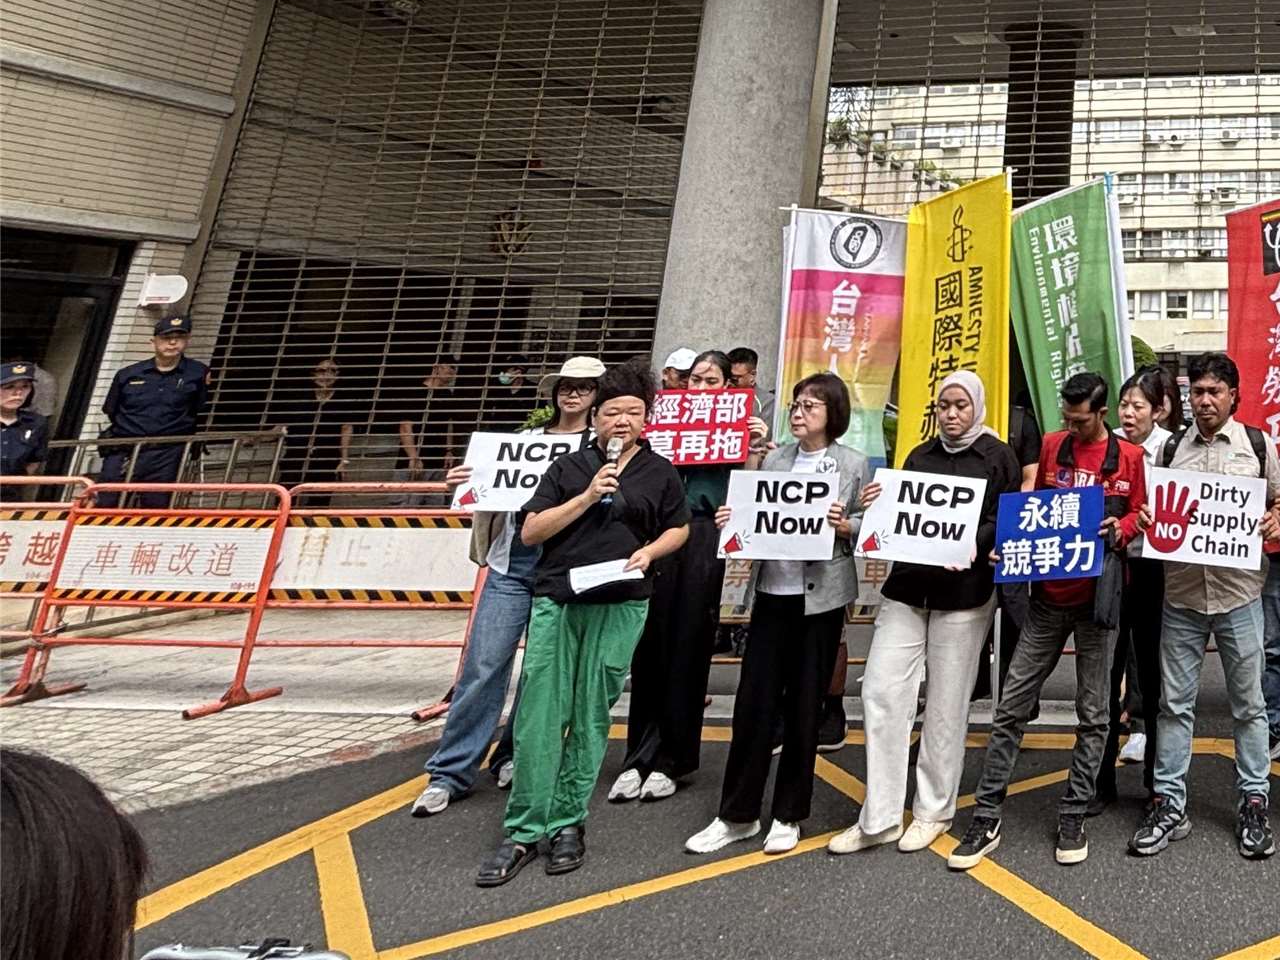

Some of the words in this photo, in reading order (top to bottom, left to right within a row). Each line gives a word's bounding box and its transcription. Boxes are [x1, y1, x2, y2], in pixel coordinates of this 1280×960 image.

[1028, 225, 1059, 341] Environmental
[963, 266, 983, 353] AMNESTY
[648, 392, 748, 425] 經濟部
[496, 442, 572, 462] NCP
[646, 428, 744, 461] 莫再拖
[756, 480, 830, 504] NCP
[898, 480, 975, 510] NCP
[1199, 482, 1251, 506] Dirty
[755, 511, 824, 535] Now
[894, 512, 967, 541] Now
[1019, 492, 1081, 533] 永續
[1189, 509, 1258, 536] Supply
[1155, 522, 1182, 541] NO
[90, 541, 239, 577] 車輛改道
[1002, 536, 1095, 577] 競爭力
[1191, 535, 1249, 558] Chain
